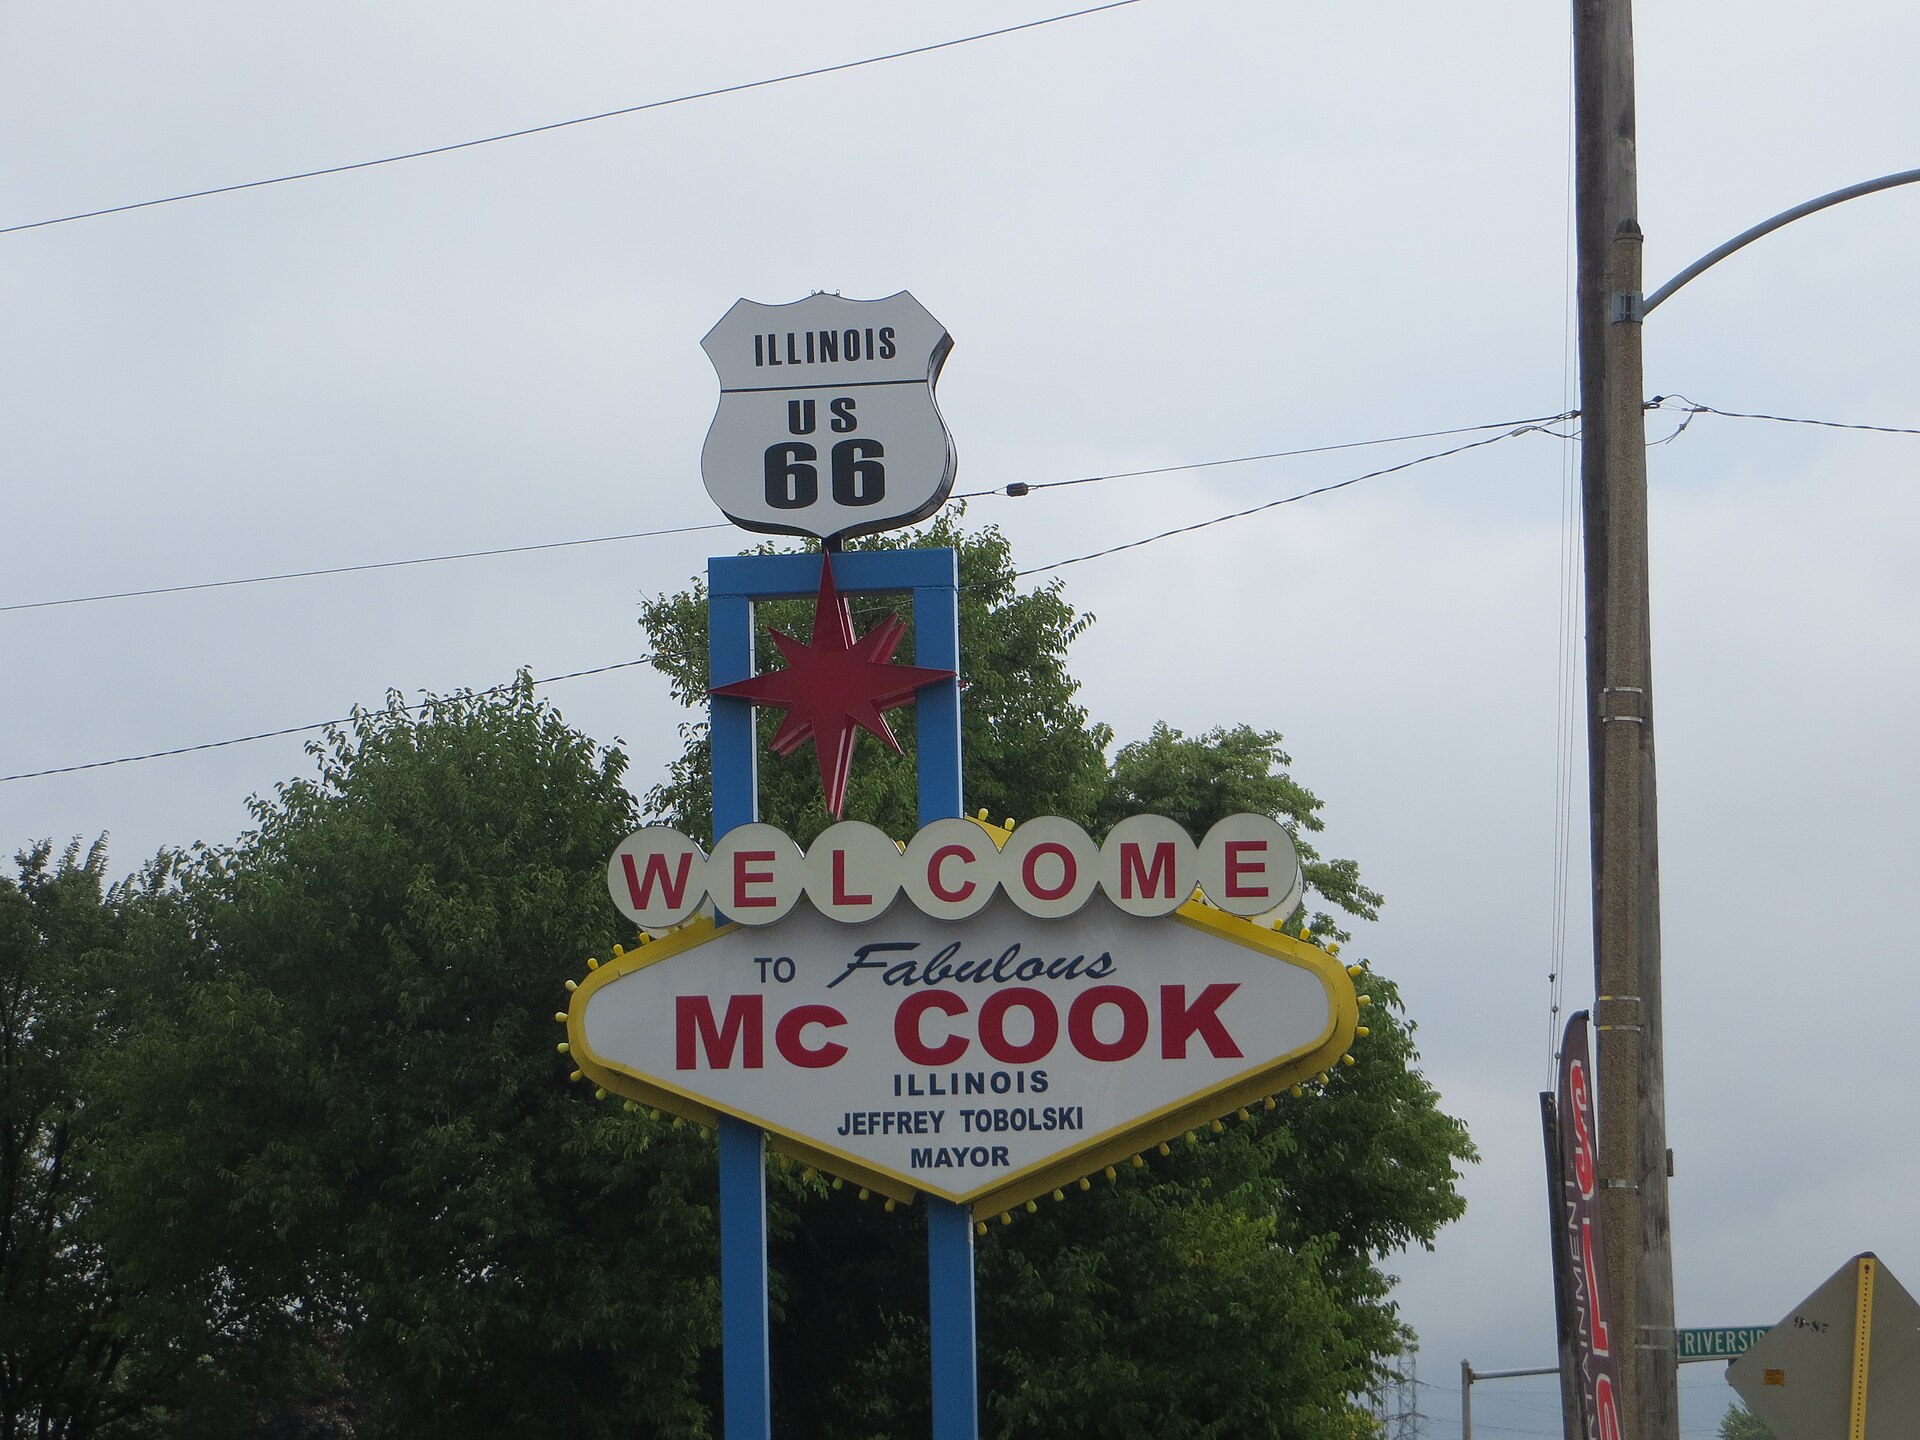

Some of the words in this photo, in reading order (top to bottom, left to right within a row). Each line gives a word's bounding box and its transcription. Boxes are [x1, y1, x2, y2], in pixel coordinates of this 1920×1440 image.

[754, 326, 896, 367] ILLINOIS
[764, 438, 886, 510] 66
[620, 841, 1270, 910] WELCOME
[754, 956, 796, 984] TO
[826, 941, 1117, 989] Fabulous
[894, 983, 1243, 1066] COOK
[894, 1069, 1049, 1097] ILLINOIS
[837, 1110, 945, 1137] JEFFREY
[960, 1106, 1083, 1133] TOBOLSKI
[911, 1146, 1010, 1169] MAYOR
